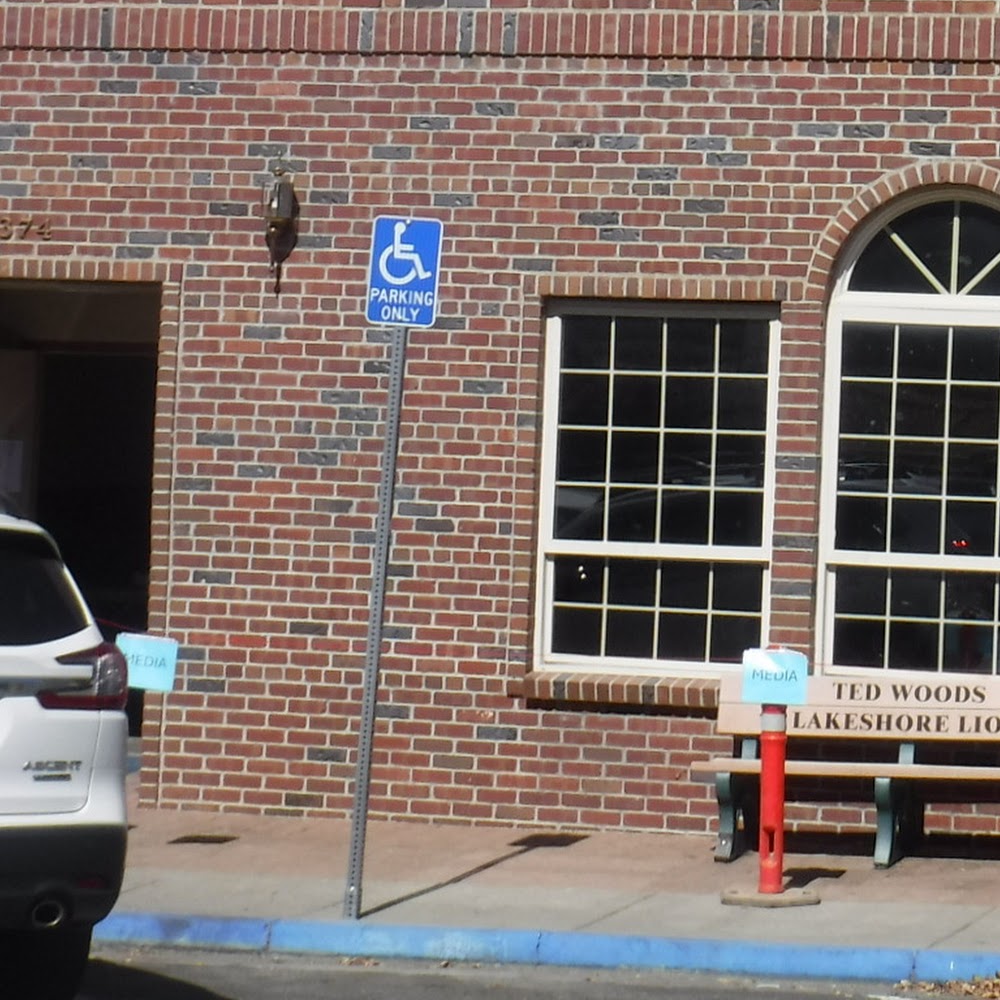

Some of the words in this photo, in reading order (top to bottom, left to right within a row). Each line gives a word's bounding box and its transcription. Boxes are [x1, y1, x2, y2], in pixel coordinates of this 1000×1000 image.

[370, 287, 433, 307] PARKING
[381, 305, 420, 322] ONLY
[752, 668, 798, 682] MEDIA
[833, 682, 881, 701] TED
[892, 684, 986, 703] WOODS
[793, 711, 949, 732] LAKESHORE
